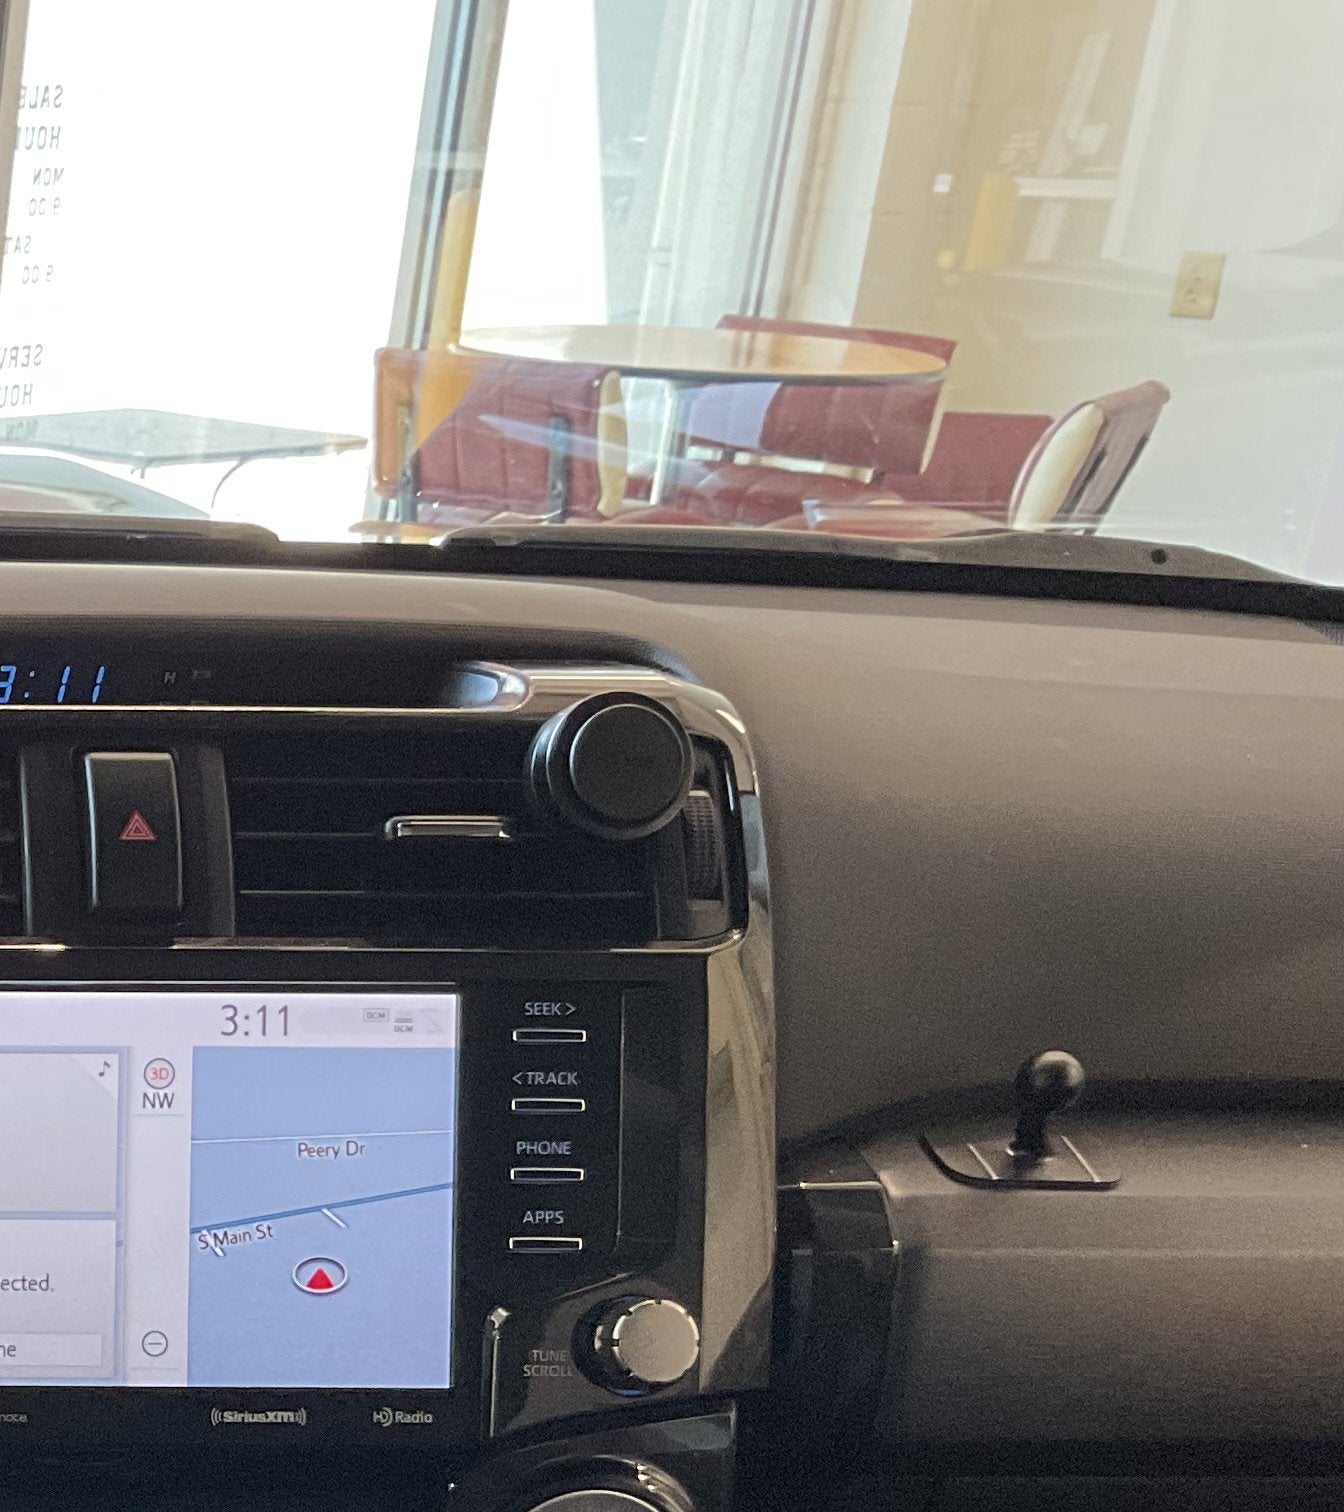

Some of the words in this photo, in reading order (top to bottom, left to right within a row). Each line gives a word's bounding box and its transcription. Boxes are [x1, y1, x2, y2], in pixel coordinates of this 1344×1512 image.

[524, 1002, 562, 1016] SEEK
[220, 1004, 289, 1037] 3:11
[149, 1067, 170, 1081] 3D
[526, 1071, 578, 1086] TRACK
[142, 1091, 175, 1109] NW
[297, 1142, 341, 1160] Peery
[346, 1140, 366, 1156] Dr
[516, 1141, 572, 1155] PHONE
[522, 1210, 565, 1225] APPS
[198, 1234, 209, 1251] S
[213, 1230, 253, 1248] Main
[255, 1224, 274, 1241] St
[531, 1349, 567, 1362] TUNE
[522, 1364, 574, 1378] SCROLL
[395, 1411, 433, 1424] Radio
